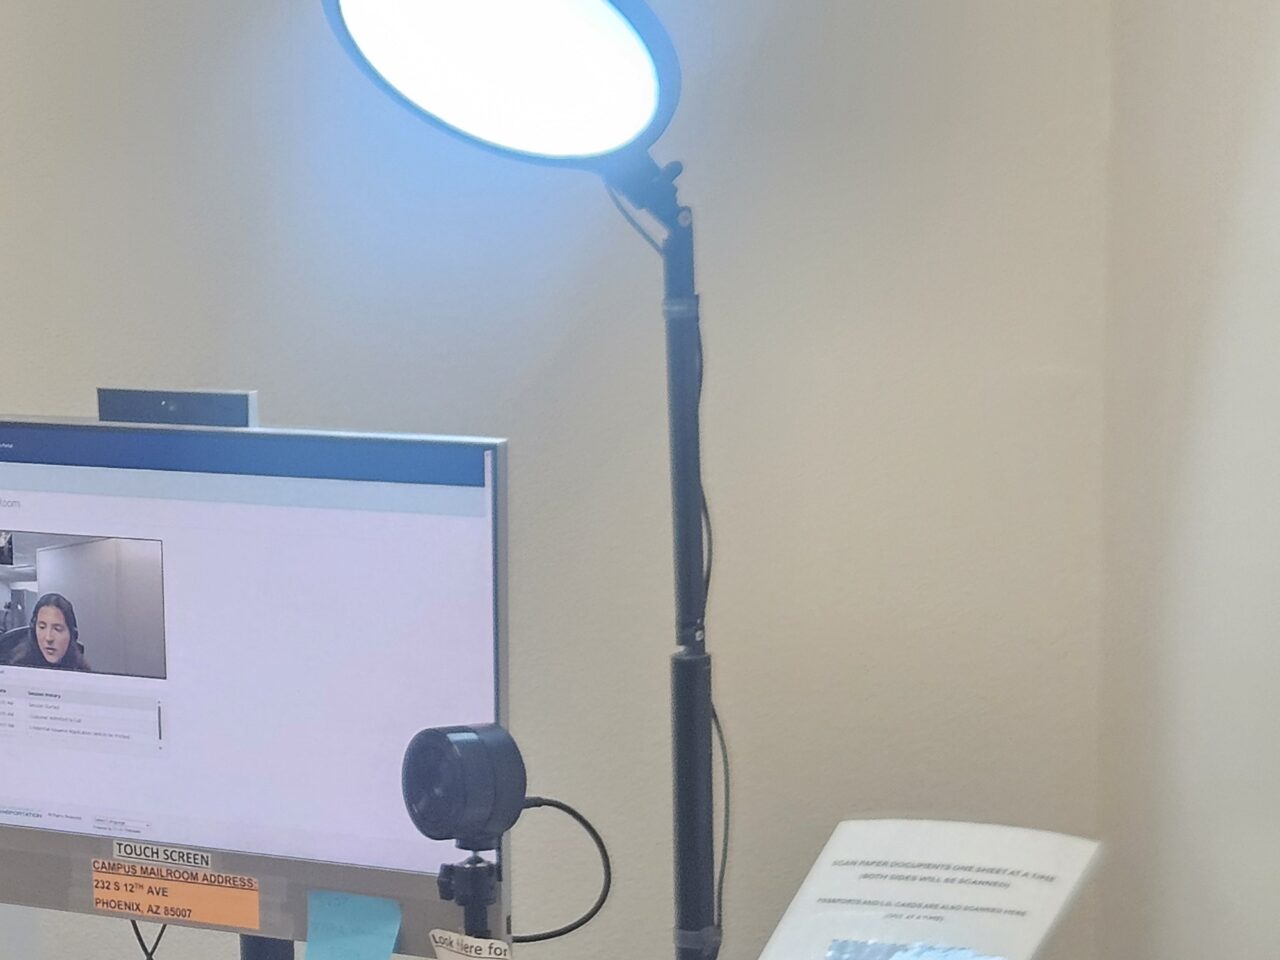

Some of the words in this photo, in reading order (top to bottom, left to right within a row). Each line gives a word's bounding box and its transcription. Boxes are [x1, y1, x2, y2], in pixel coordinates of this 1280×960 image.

[116, 842, 159, 859] TOUCH
[163, 849, 210, 866] SCREEN
[93, 860, 137, 875] CAMPUS
[140, 866, 198, 882] MAILROOM
[202, 873, 257, 888] ADDRESS:
[94, 879, 111, 891] 232
[114, 882, 120, 891] S
[147, 887, 169, 897] AVE
[147, 904, 160, 915] AZ
[164, 906, 192, 918] 85007
[431, 933, 454, 948] Look
[456, 937, 483, 955] Here
[488, 942, 508, 957] for
